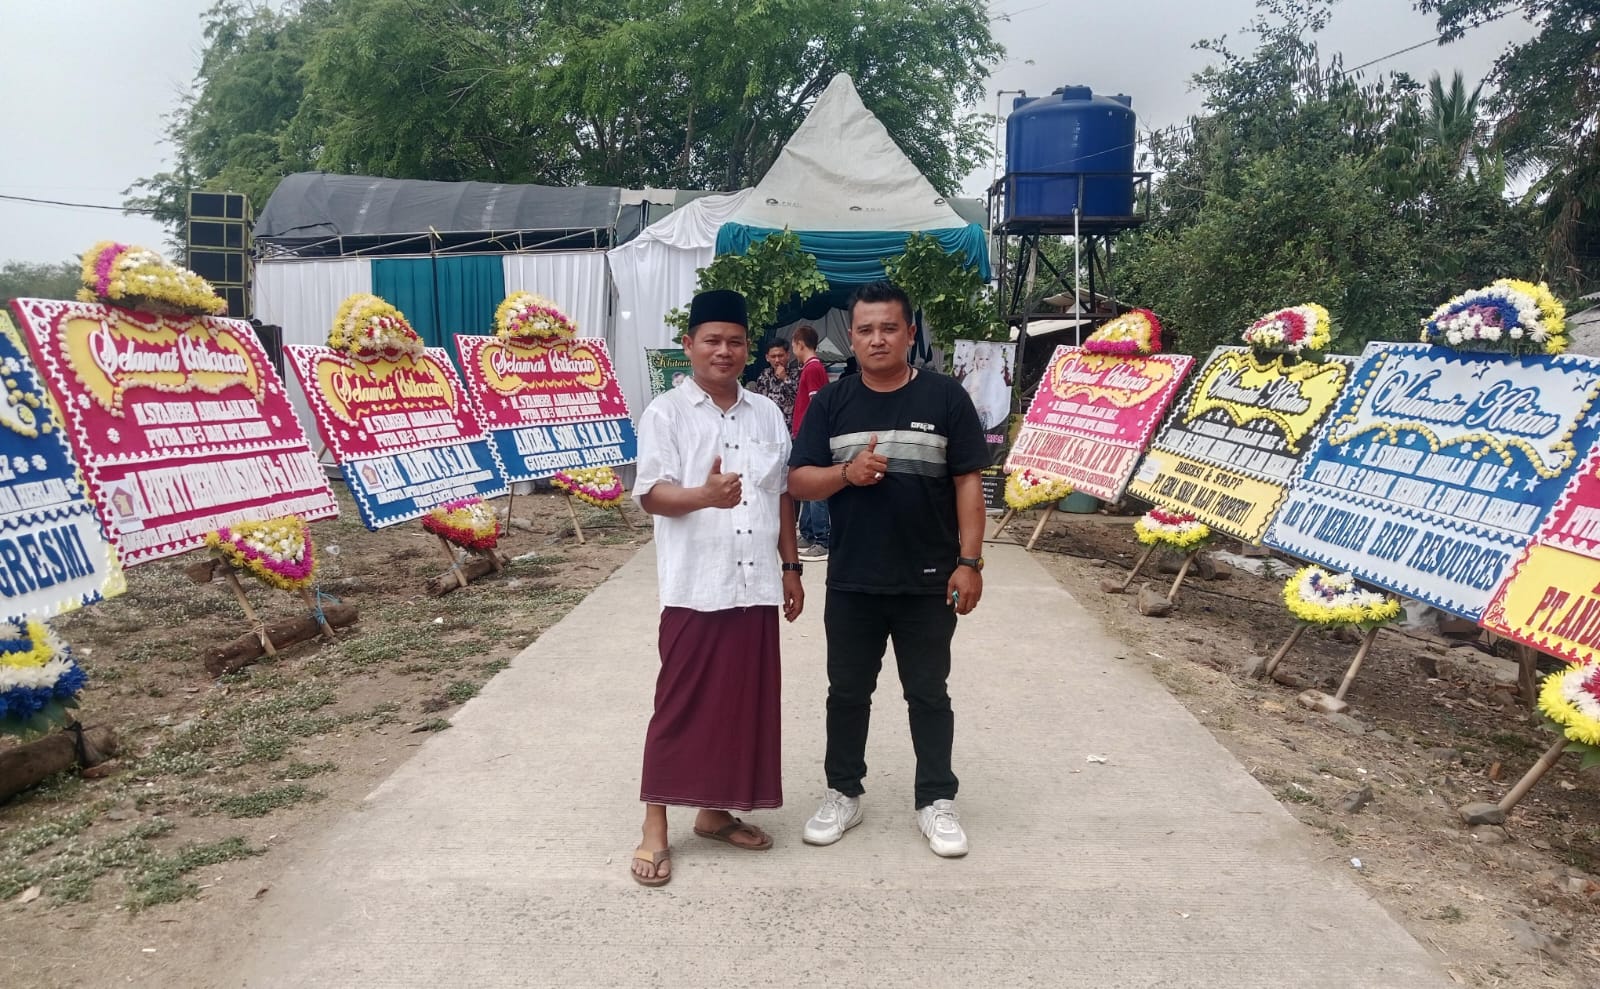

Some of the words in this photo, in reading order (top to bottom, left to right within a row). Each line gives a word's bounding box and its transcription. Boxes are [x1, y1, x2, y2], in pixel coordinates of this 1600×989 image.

[89, 320, 180, 383] Selamat
[178, 332, 249, 374] Khitanan
[491, 348, 547, 380] Selamat
[547, 348, 596, 373] Khitanan
[333, 365, 396, 410] Selamat
[394, 369, 445, 399] Khitanan
[1058, 354, 1104, 386] Selamat
[1258, 375, 1311, 413] Khitan
[1466, 381, 1558, 435] Khitan
[512, 426, 557, 455] ANDRA
[523, 450, 584, 472] GUBERNUR
[580, 444, 624, 465] BANTEN
[1174, 460, 1206, 479] DIREKSI
[1203, 468, 1214, 483] &
[1213, 472, 1245, 490] STAFF
[1313, 506, 1377, 552] MENARA
[1368, 520, 1420, 562] BIRU
[1406, 531, 1511, 591] RESOURCES
